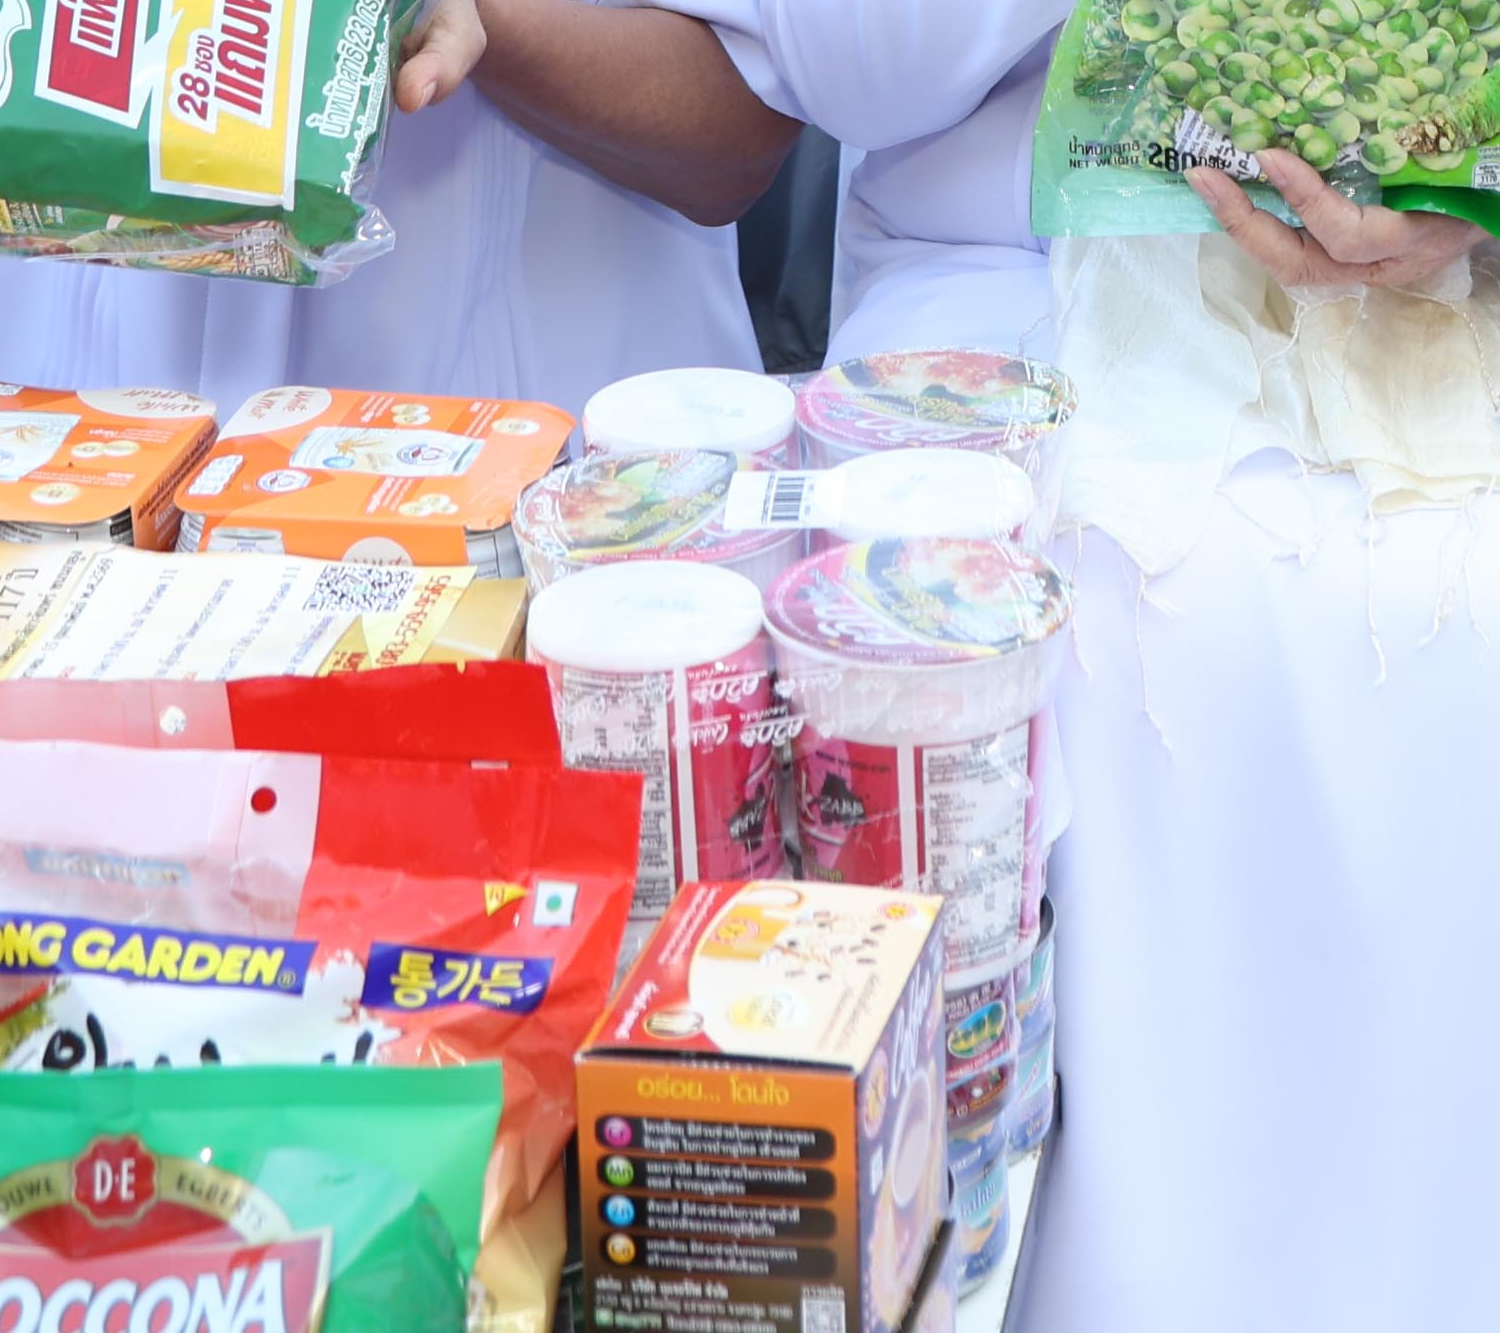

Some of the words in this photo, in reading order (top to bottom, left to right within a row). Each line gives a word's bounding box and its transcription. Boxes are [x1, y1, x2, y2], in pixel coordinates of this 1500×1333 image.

[195, 35, 215, 74] ซอง
[177, 73, 214, 121] 28
[1069, 136, 1141, 157] น้ำหนักสุทธิ
[1069, 157, 1092, 169] NET
[1094, 156, 1141, 168] WEIGHT
[71, 928, 280, 986] GARDEN
[390, 944, 526, 1012] 통가든
[730, 1079, 790, 1106] โดนใจ
[175, 1173, 270, 1229] EGBERTS
